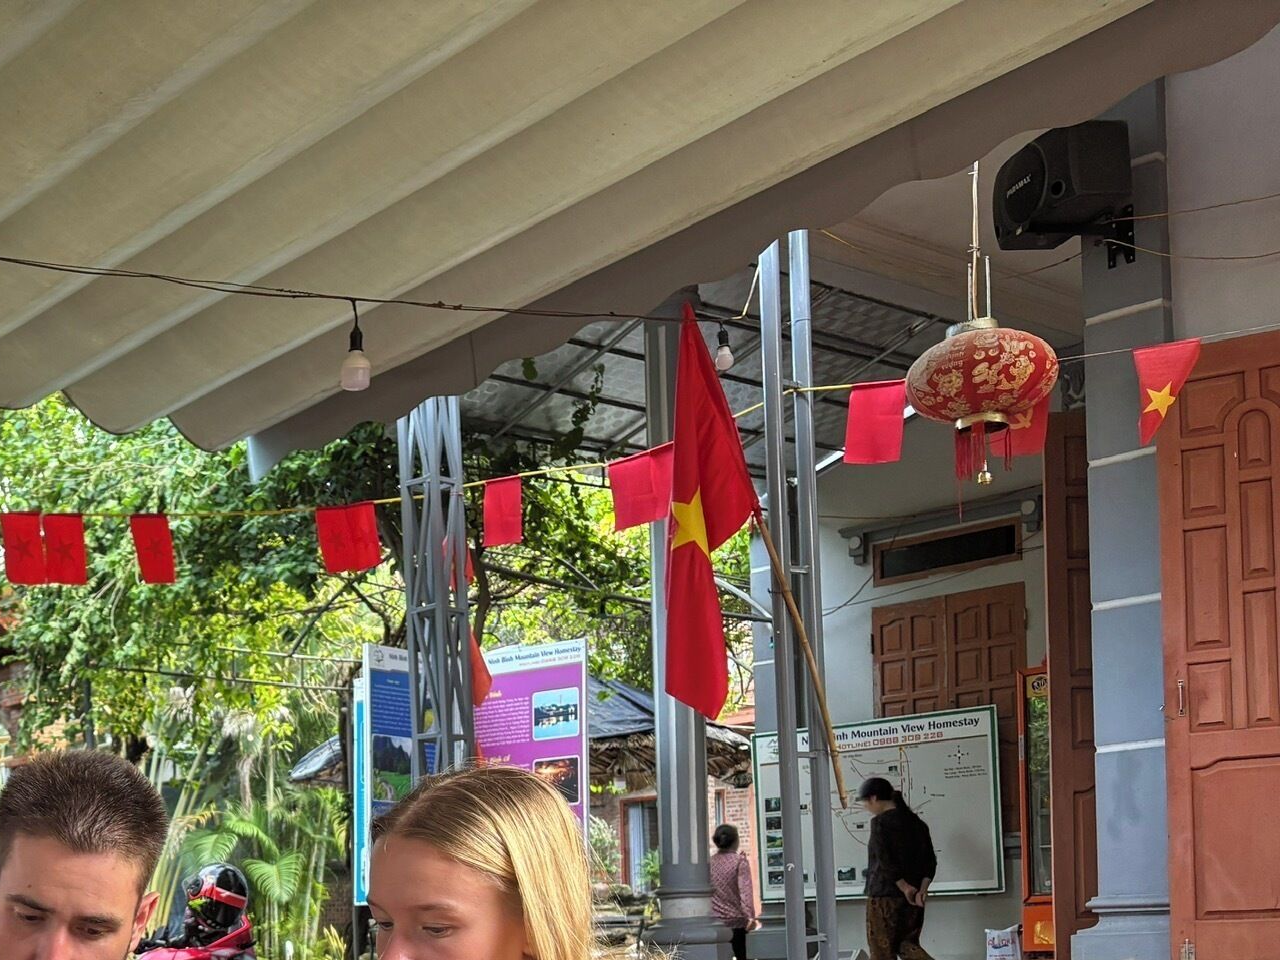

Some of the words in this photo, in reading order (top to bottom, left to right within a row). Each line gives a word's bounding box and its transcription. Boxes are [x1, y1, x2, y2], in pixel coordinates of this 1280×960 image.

[834, 732, 849, 742] inh
[851, 727, 898, 740] Mountain
[901, 722, 925, 733] View
[928, 717, 980, 732] Homestay
